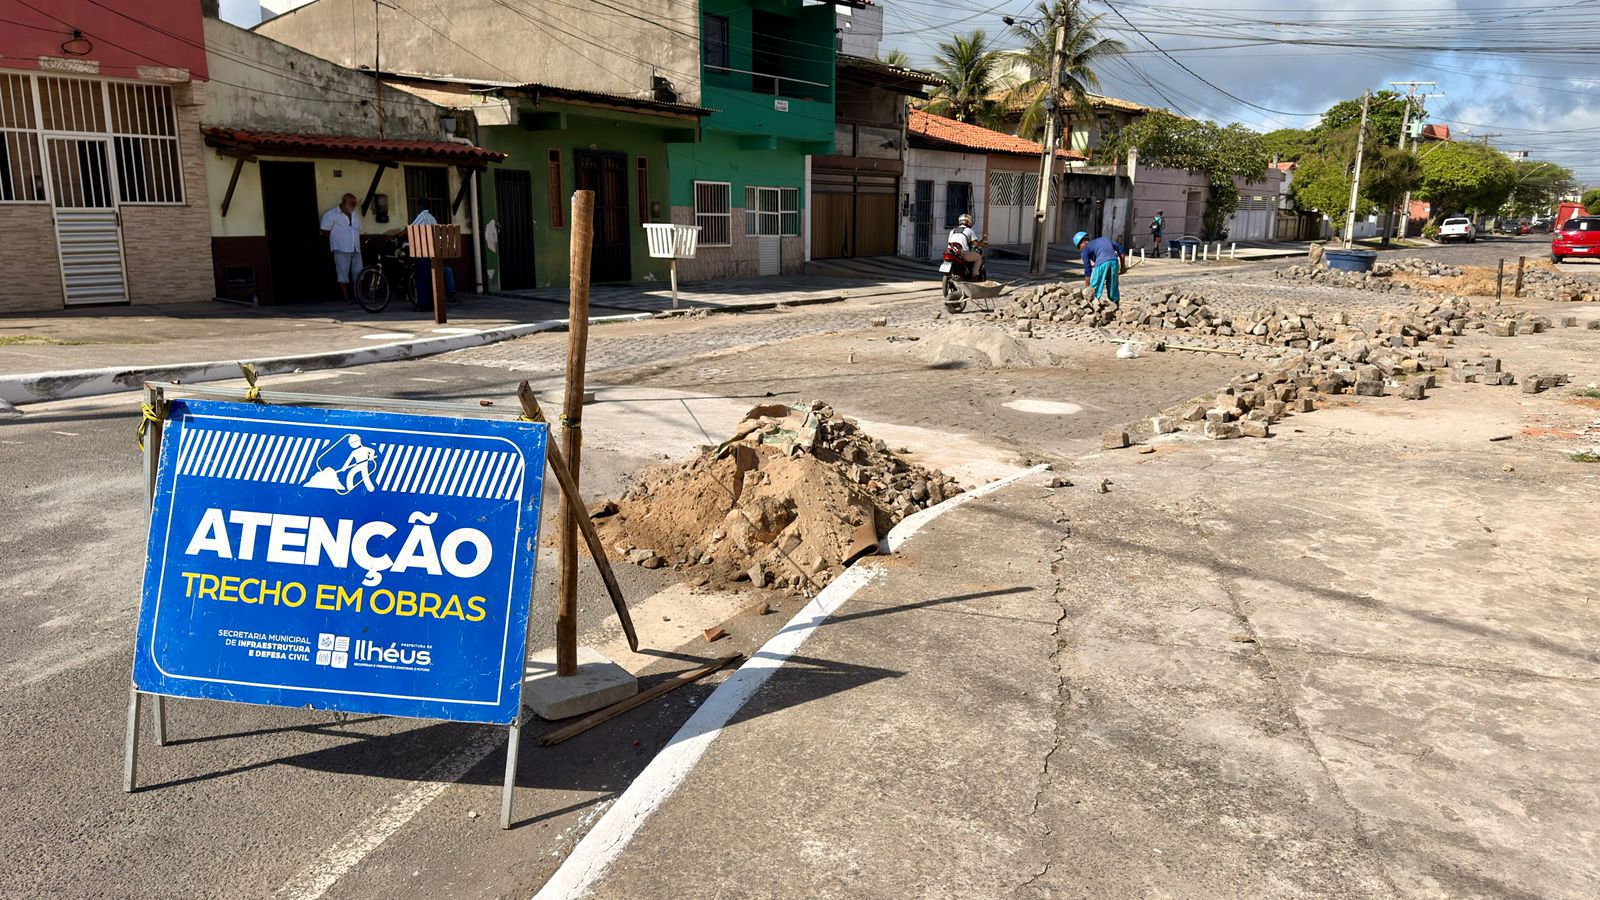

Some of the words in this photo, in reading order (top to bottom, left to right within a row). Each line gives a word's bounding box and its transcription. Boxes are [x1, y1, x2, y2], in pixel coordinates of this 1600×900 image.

[185, 507, 493, 587] ATENÇÃO
[181, 571, 306, 607] TRECHO
[315, 584, 363, 613] EM
[370, 589, 486, 622] OBRAS
[218, 629, 266, 640] SECRETARIA
[268, 634, 311, 644] MUNICIPAL
[238, 640, 310, 653] INFRAESTRUTURA
[248, 649, 254, 657] E
[255, 650, 286, 660] DEFESA
[288, 653, 309, 661] CIVIL
[354, 639, 431, 665] Ilhéus
